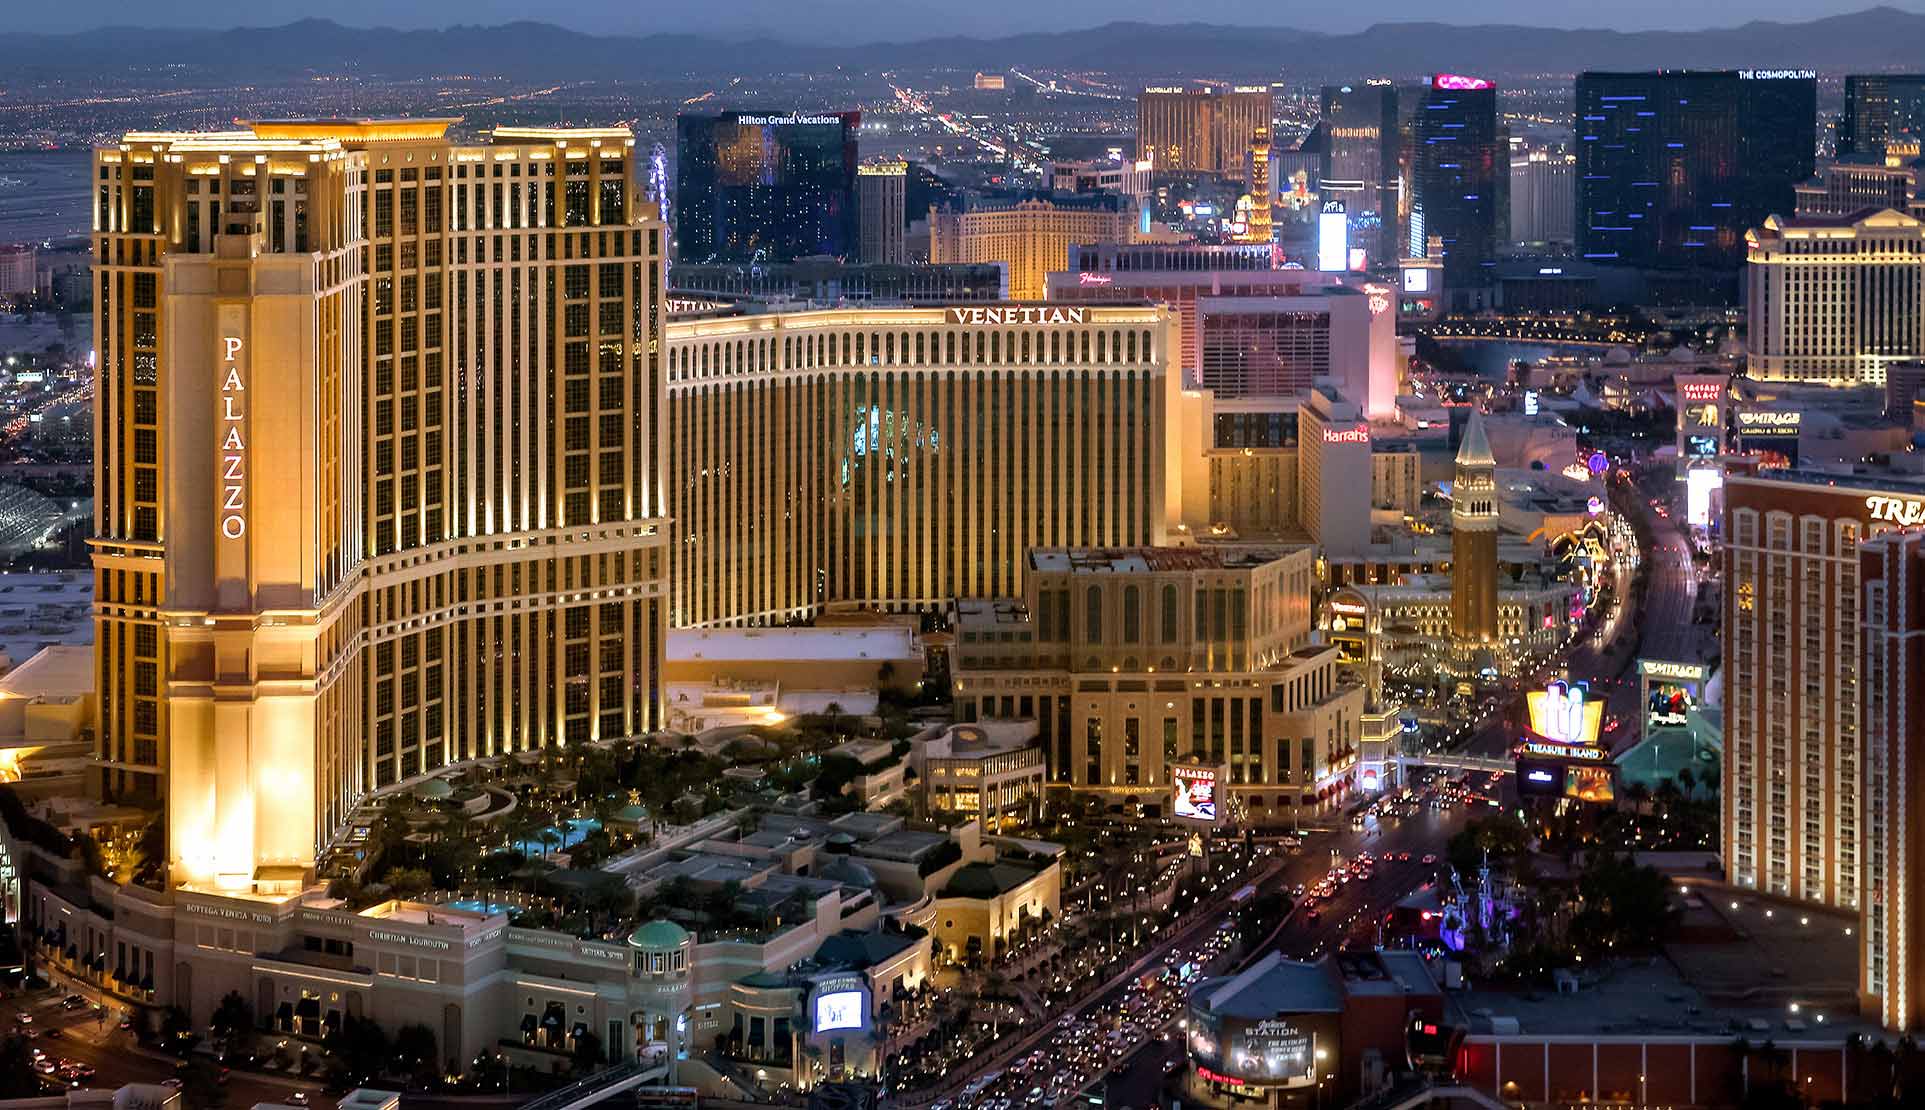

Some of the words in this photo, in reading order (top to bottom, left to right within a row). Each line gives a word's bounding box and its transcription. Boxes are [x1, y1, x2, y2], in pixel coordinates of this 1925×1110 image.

[1738, 69, 1754, 80] THE
[1755, 69, 1816, 80] COSMOPOLITAN
[738, 115, 767, 125] Hilton
[767, 114, 796, 126] Grand
[796, 115, 840, 125] Vacations
[951, 306, 1086, 326] VENETIAN
[1684, 383, 1721, 392] CAESARS
[1685, 391, 1719, 400] PALACE
[222, 336, 246, 540] PALAZZO
[1528, 743, 1567, 756] TREASURE
[1569, 747, 1600, 759] ISLAND
[1175, 767, 1216, 780] PALAZZO
[1245, 1027, 1299, 1037] STATION
